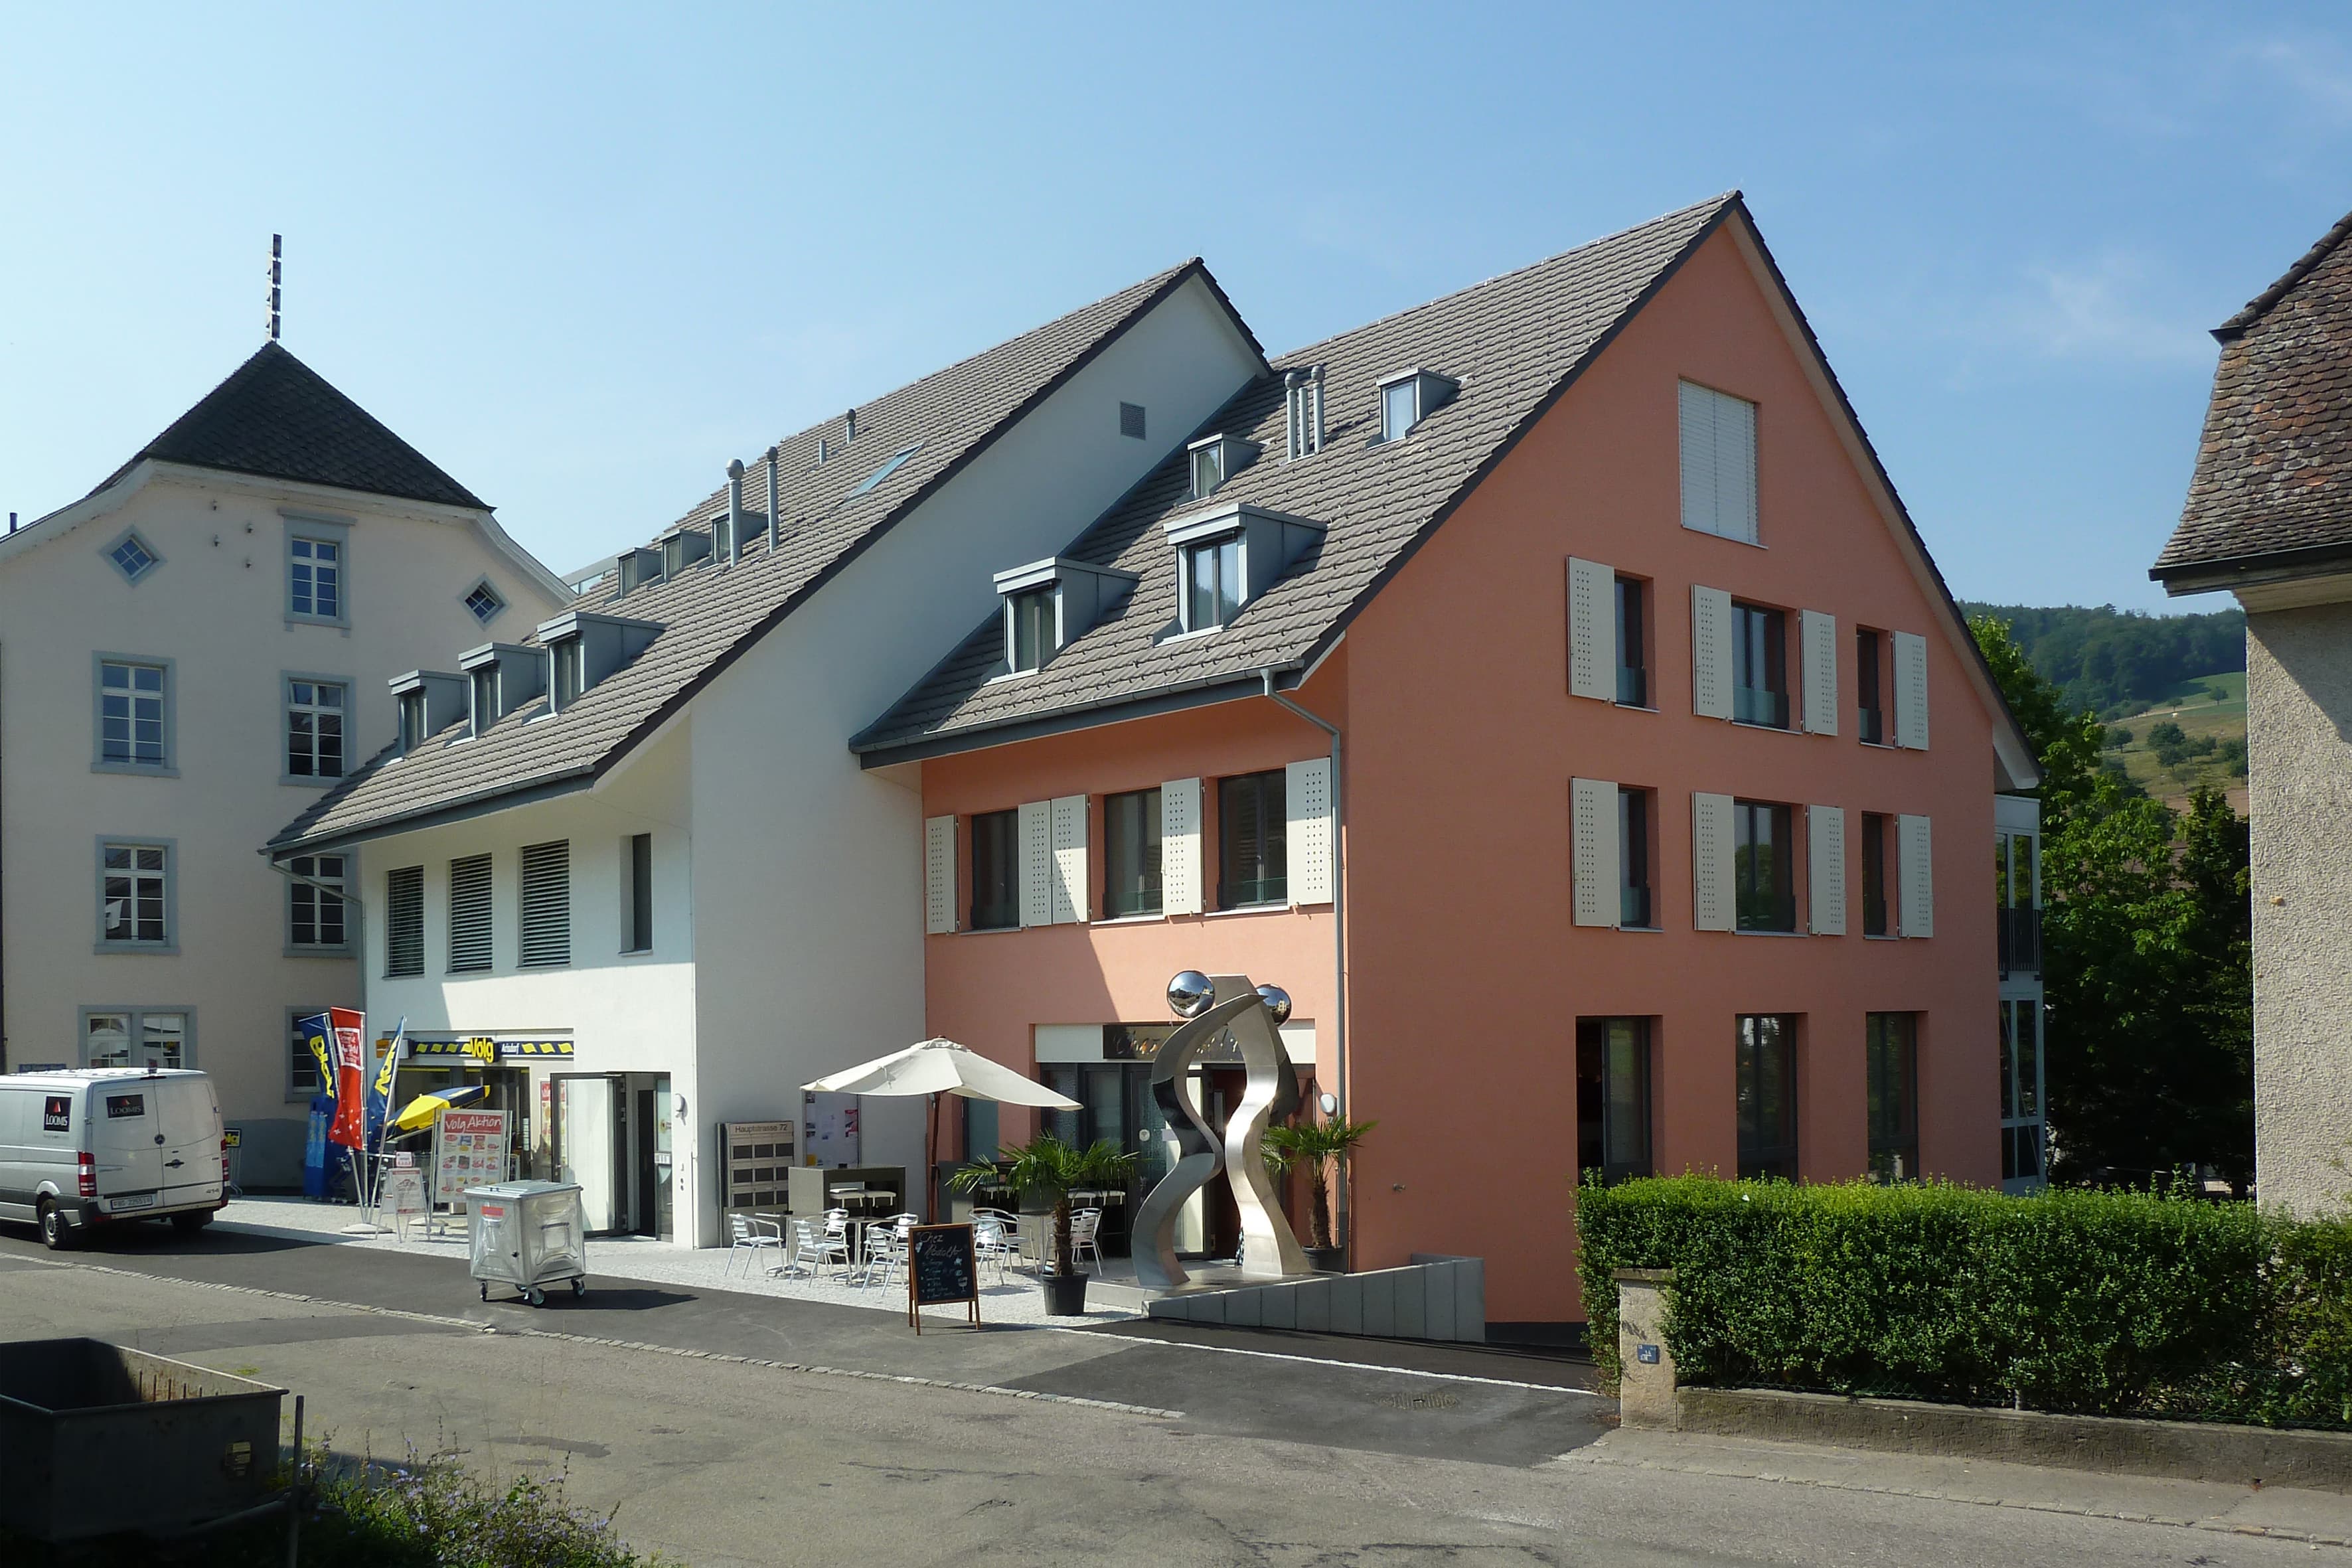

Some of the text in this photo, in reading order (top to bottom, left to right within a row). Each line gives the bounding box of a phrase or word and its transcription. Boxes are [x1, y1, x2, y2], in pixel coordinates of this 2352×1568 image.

[470, 1037, 494, 1063] Volg
[110, 1106, 142, 1115] LOOMIS
[46, 1114, 68, 1126] LOOMIS
[467, 1116, 502, 1129] Aktion
[735, 1125, 777, 1134] Hauptstrasse
